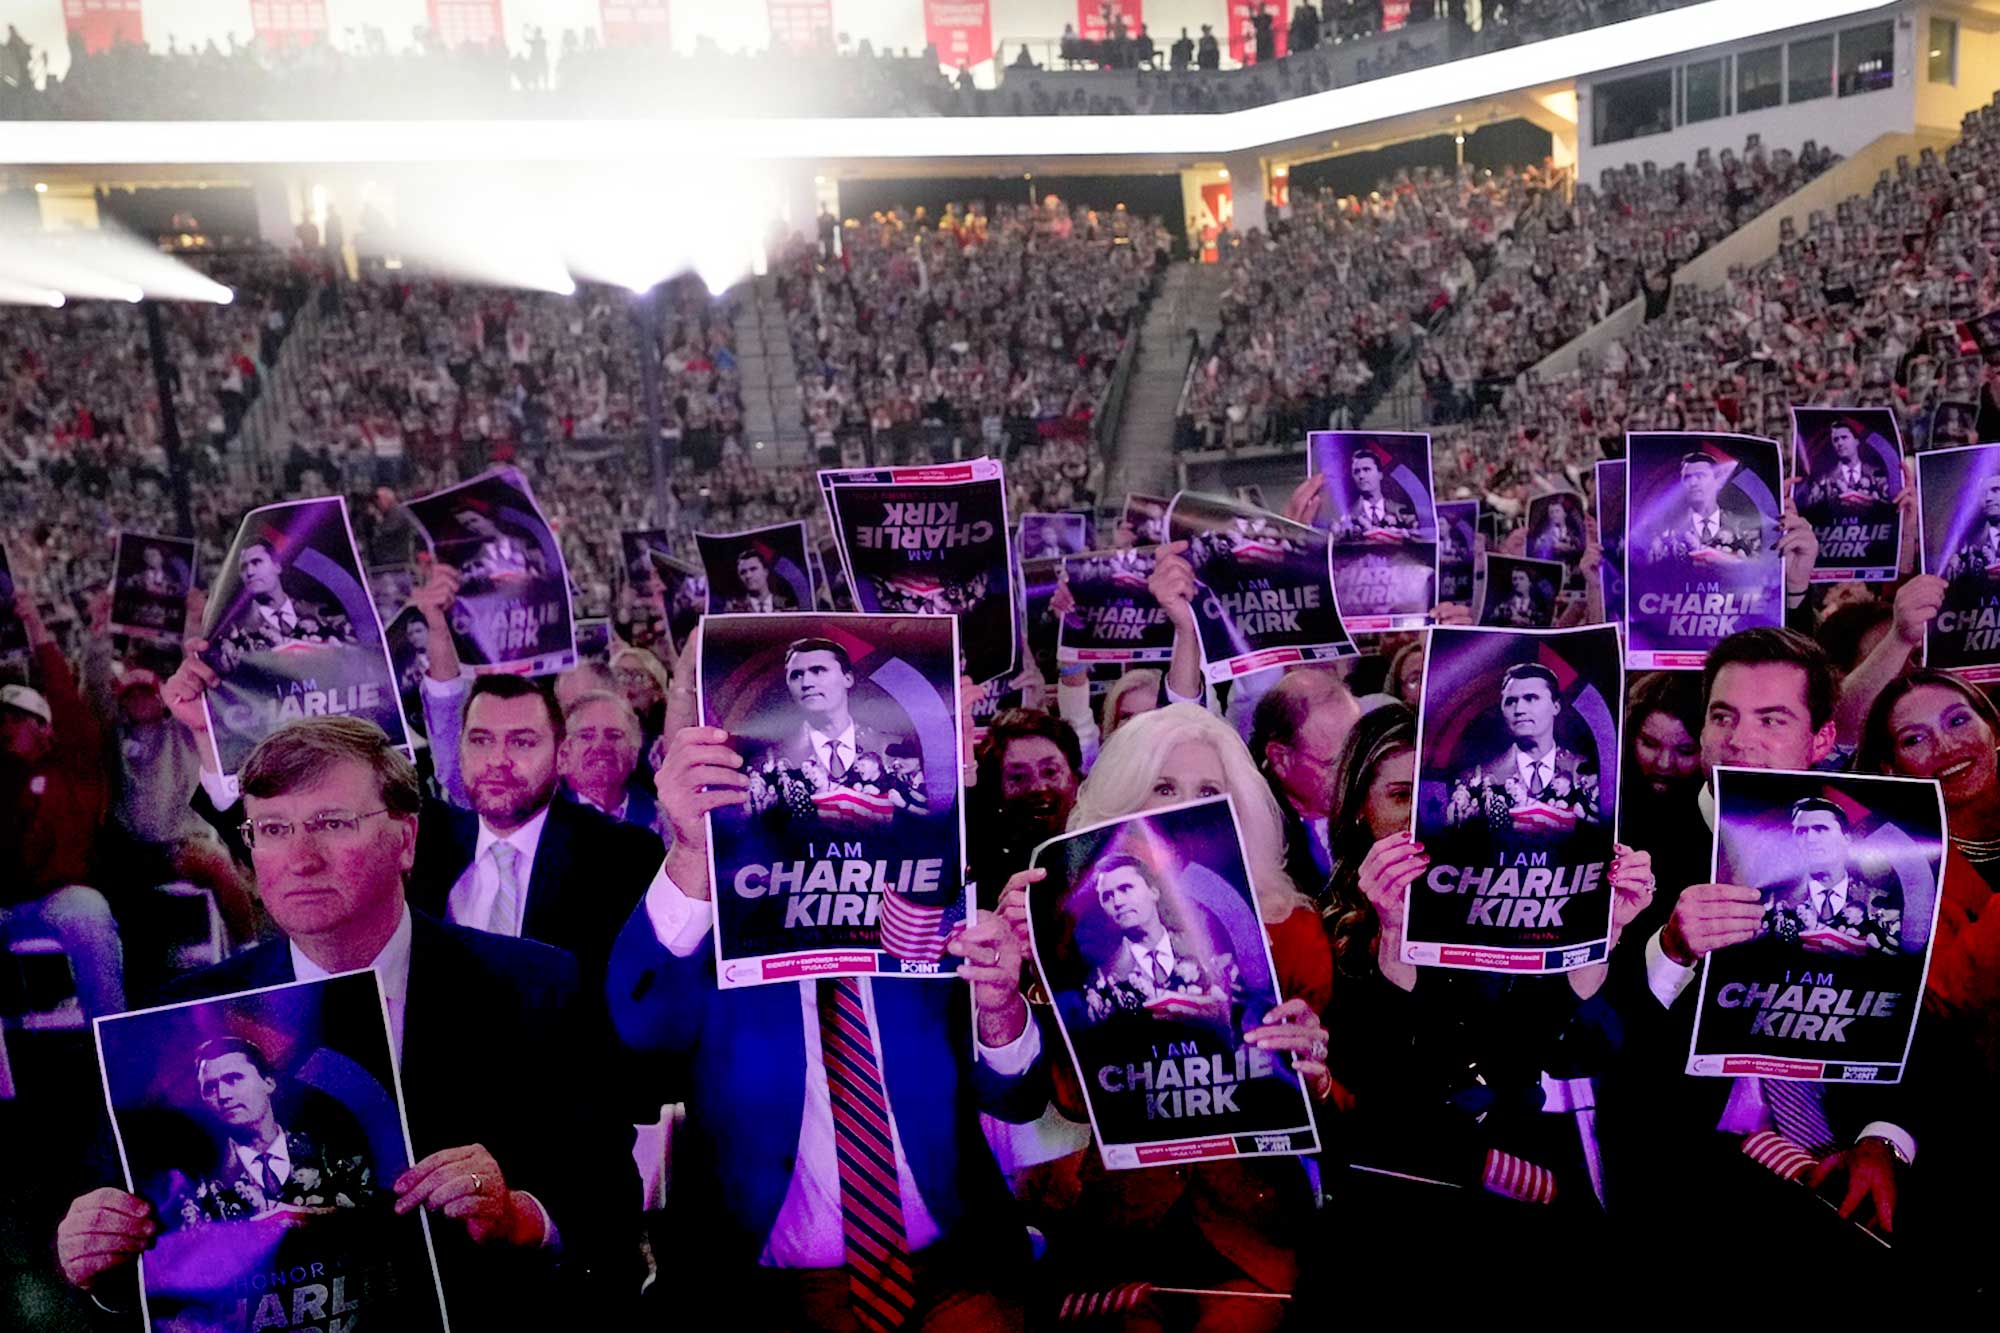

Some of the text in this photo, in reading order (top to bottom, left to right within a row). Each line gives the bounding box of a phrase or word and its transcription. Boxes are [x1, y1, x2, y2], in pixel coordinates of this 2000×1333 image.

[882, 502, 959, 526] KIRK
[1841, 517, 1858, 525] AM
[856, 520, 994, 550] CHARLIE
[1814, 524, 1892, 541] HARLIE
[907, 550, 932, 561] AM
[1248, 578, 1271, 590] AM
[1685, 582, 1720, 593] I AM
[1203, 585, 1321, 620] CHARLIE
[1638, 592, 1767, 615] CHARLIE
[1092, 624, 1147, 639] KIRK
[1235, 611, 1302, 635] KIRK
[1667, 615, 1741, 637] KIRK
[276, 678, 318, 696] I AM
[809, 842, 862, 858] I AM
[1500, 852, 1547, 866] I AM
[734, 858, 943, 899] CHARLIE
[1427, 862, 1605, 898] CHARLIE
[785, 894, 885, 928] KIRK
[1466, 897, 1571, 928] KIRK
[900, 963, 940, 973] POINT
[1785, 970, 1833, 986] I AM
[1717, 982, 1903, 1017] CHARLIE
[1750, 1010, 1856, 1043] KIRK
[1152, 1040, 1199, 1058] I AM
[1098, 1046, 1274, 1093] CHARLIE
[1146, 1084, 1241, 1119] KIRK
